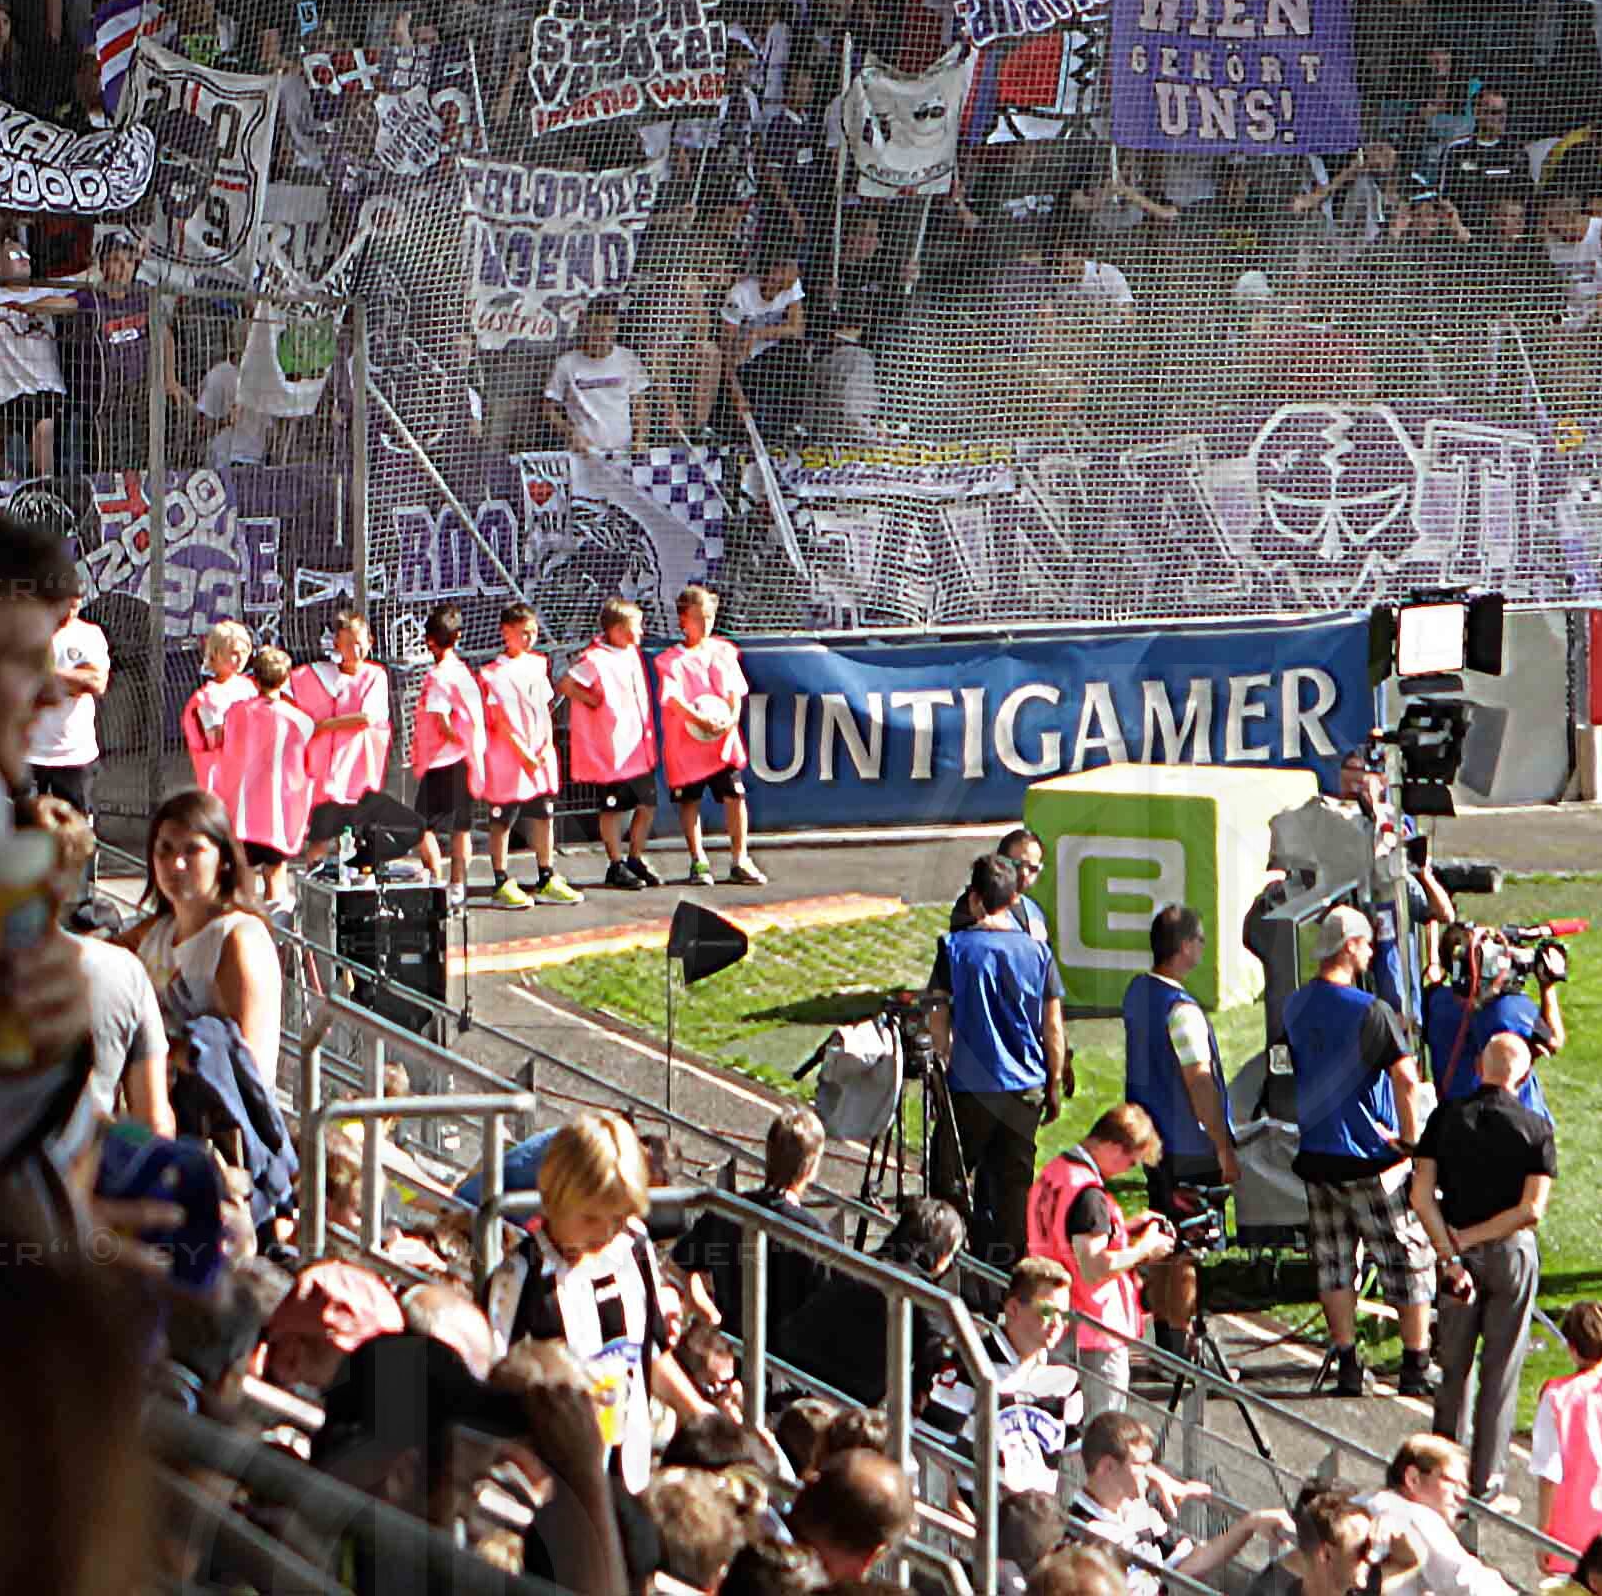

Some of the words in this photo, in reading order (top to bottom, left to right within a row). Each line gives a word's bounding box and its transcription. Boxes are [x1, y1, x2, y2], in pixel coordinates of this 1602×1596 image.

[1130, 43, 1324, 84] GEHÖRT
[1154, 81, 1296, 143] UNS!
[749, 666, 1339, 783] UNTIGAMER
